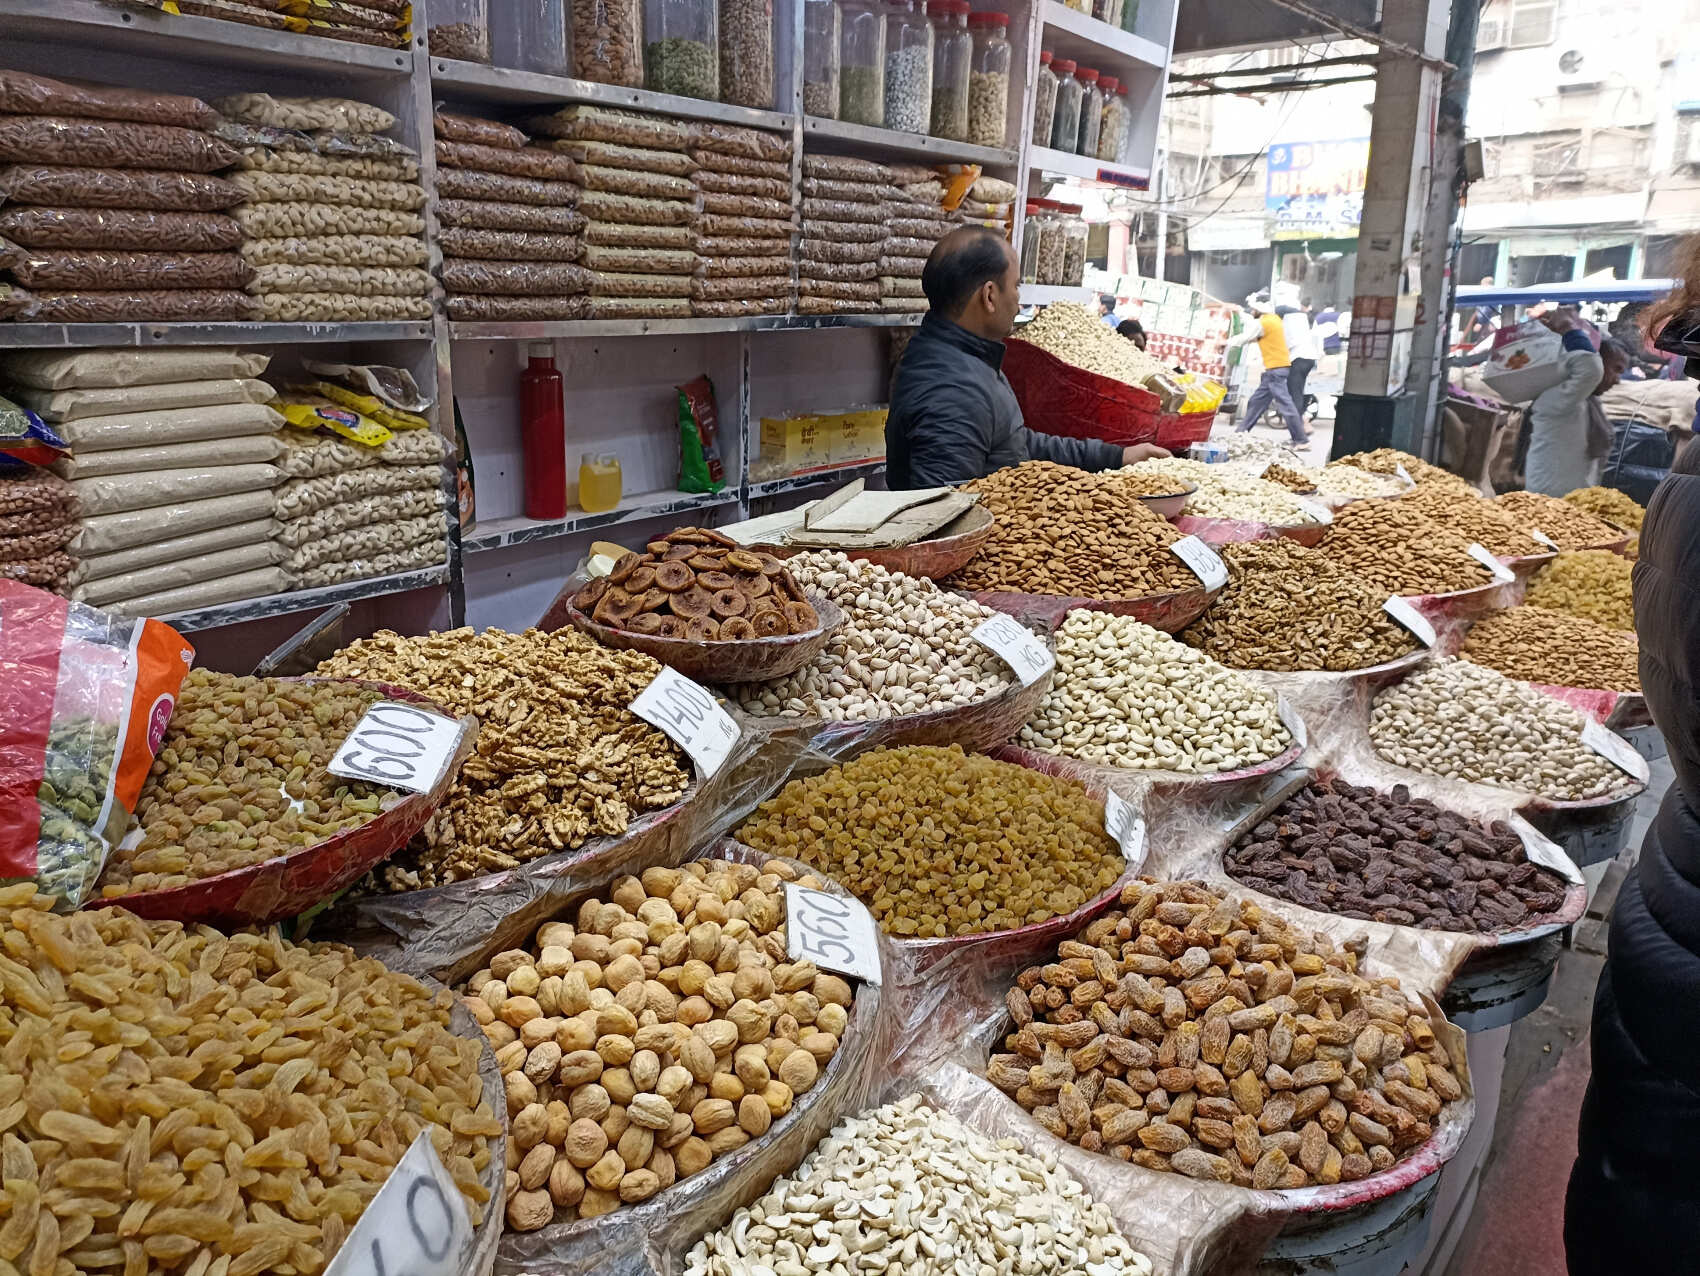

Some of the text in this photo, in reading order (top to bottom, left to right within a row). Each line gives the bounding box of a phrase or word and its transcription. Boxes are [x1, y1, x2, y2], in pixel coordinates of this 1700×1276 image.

[342, 705, 436, 780] 600
[647, 679, 713, 745] 1400
[796, 888, 856, 964] 560
